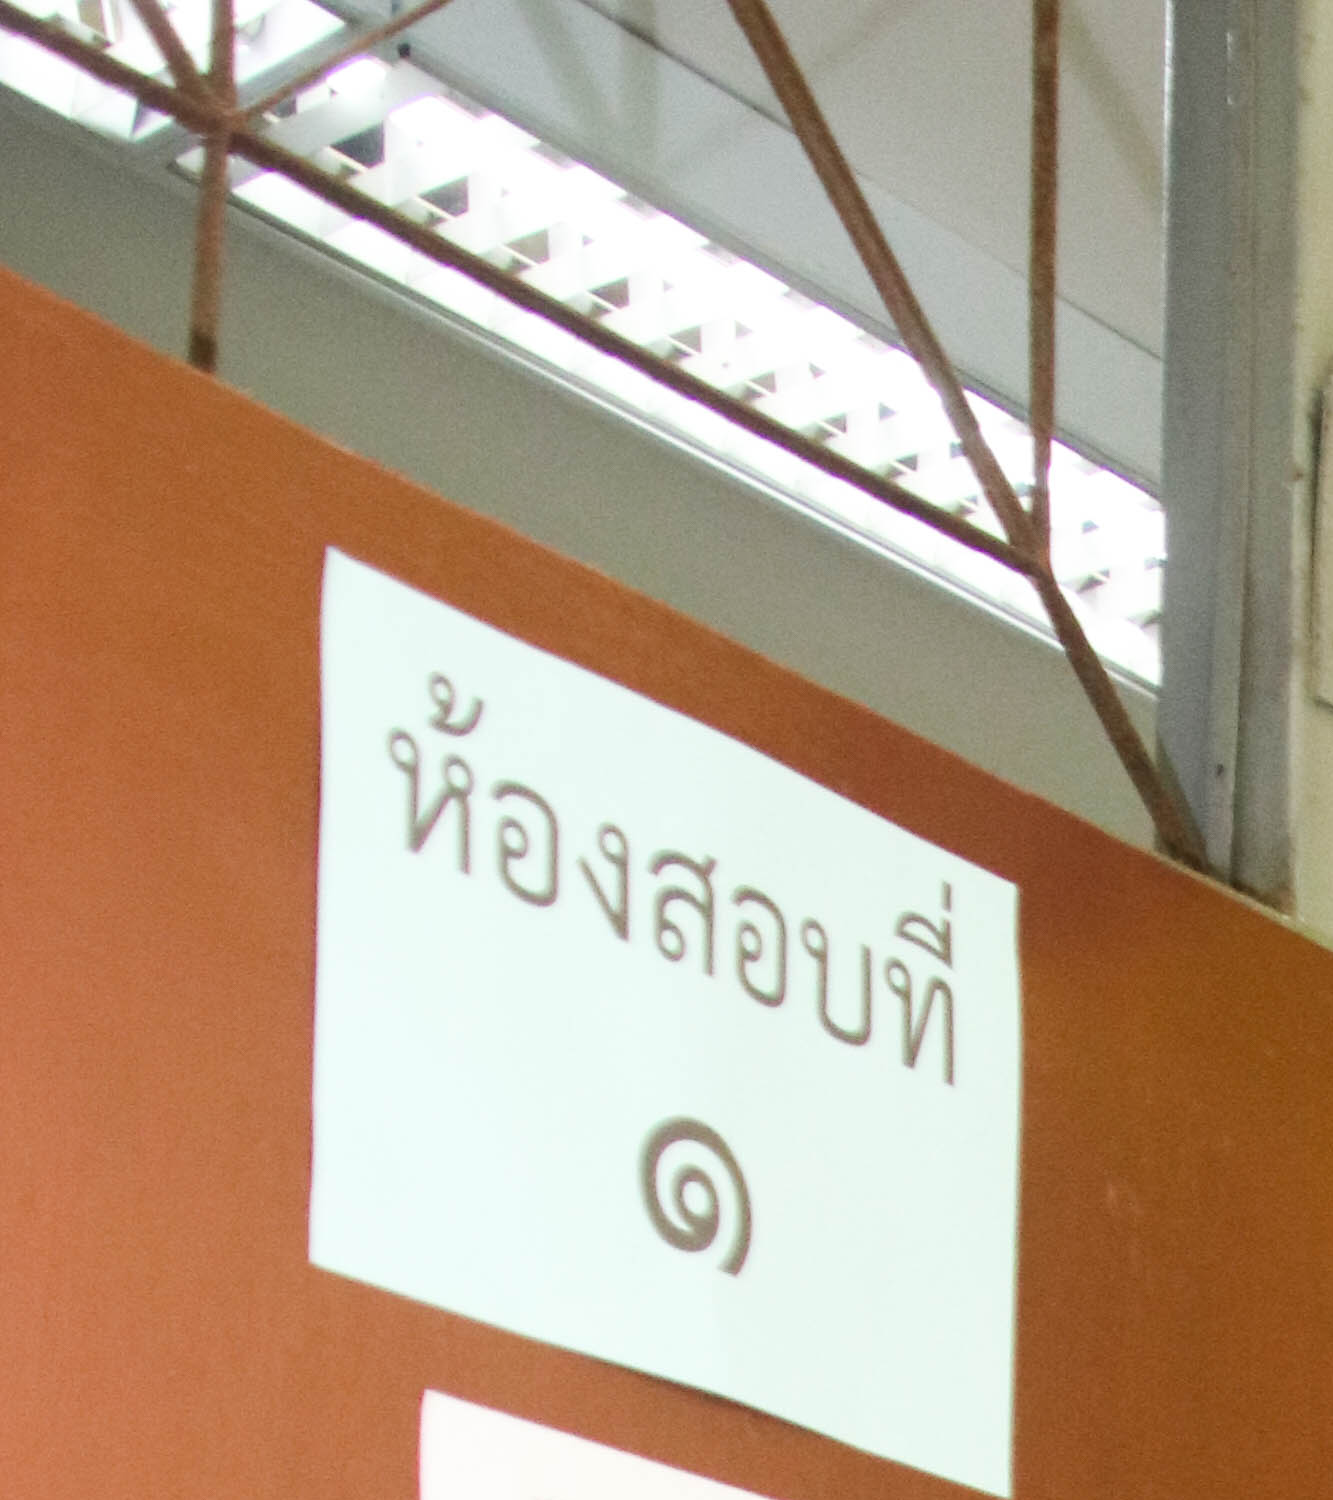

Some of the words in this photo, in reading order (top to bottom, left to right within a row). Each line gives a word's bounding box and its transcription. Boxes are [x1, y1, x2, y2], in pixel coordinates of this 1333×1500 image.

[387, 671, 956, 1087] ห้องสอบที่
[639, 1116, 754, 1278] ๑
